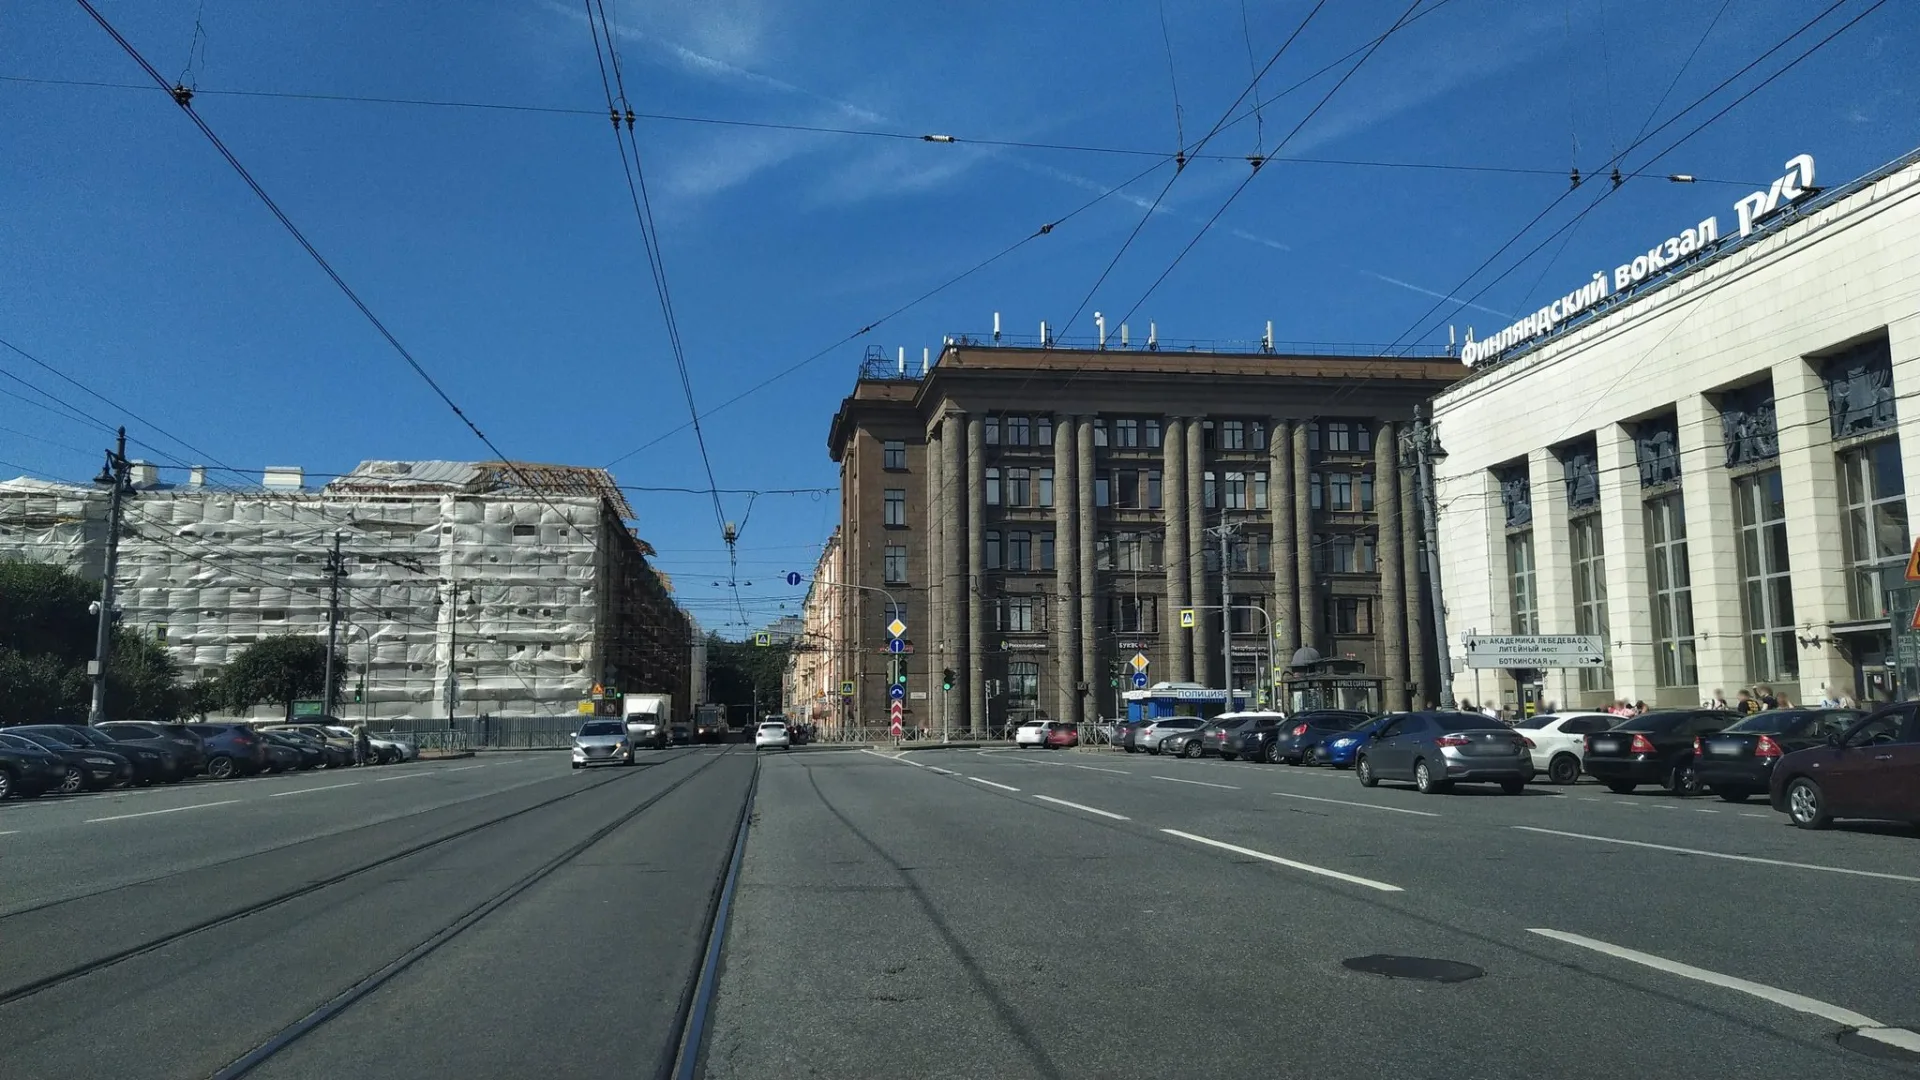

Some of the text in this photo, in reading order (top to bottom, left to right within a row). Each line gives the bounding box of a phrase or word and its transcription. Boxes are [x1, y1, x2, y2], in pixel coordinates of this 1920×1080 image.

[1538, 637, 1577, 645] ЛЕБЕДЕВА
[1498, 645, 1540, 653] ЛИТЕЙНЫЙ
[1498, 657, 1548, 665] БОТКИНСКАЯ
[1178, 690, 1224, 698] ПОЛИЦИЯ
